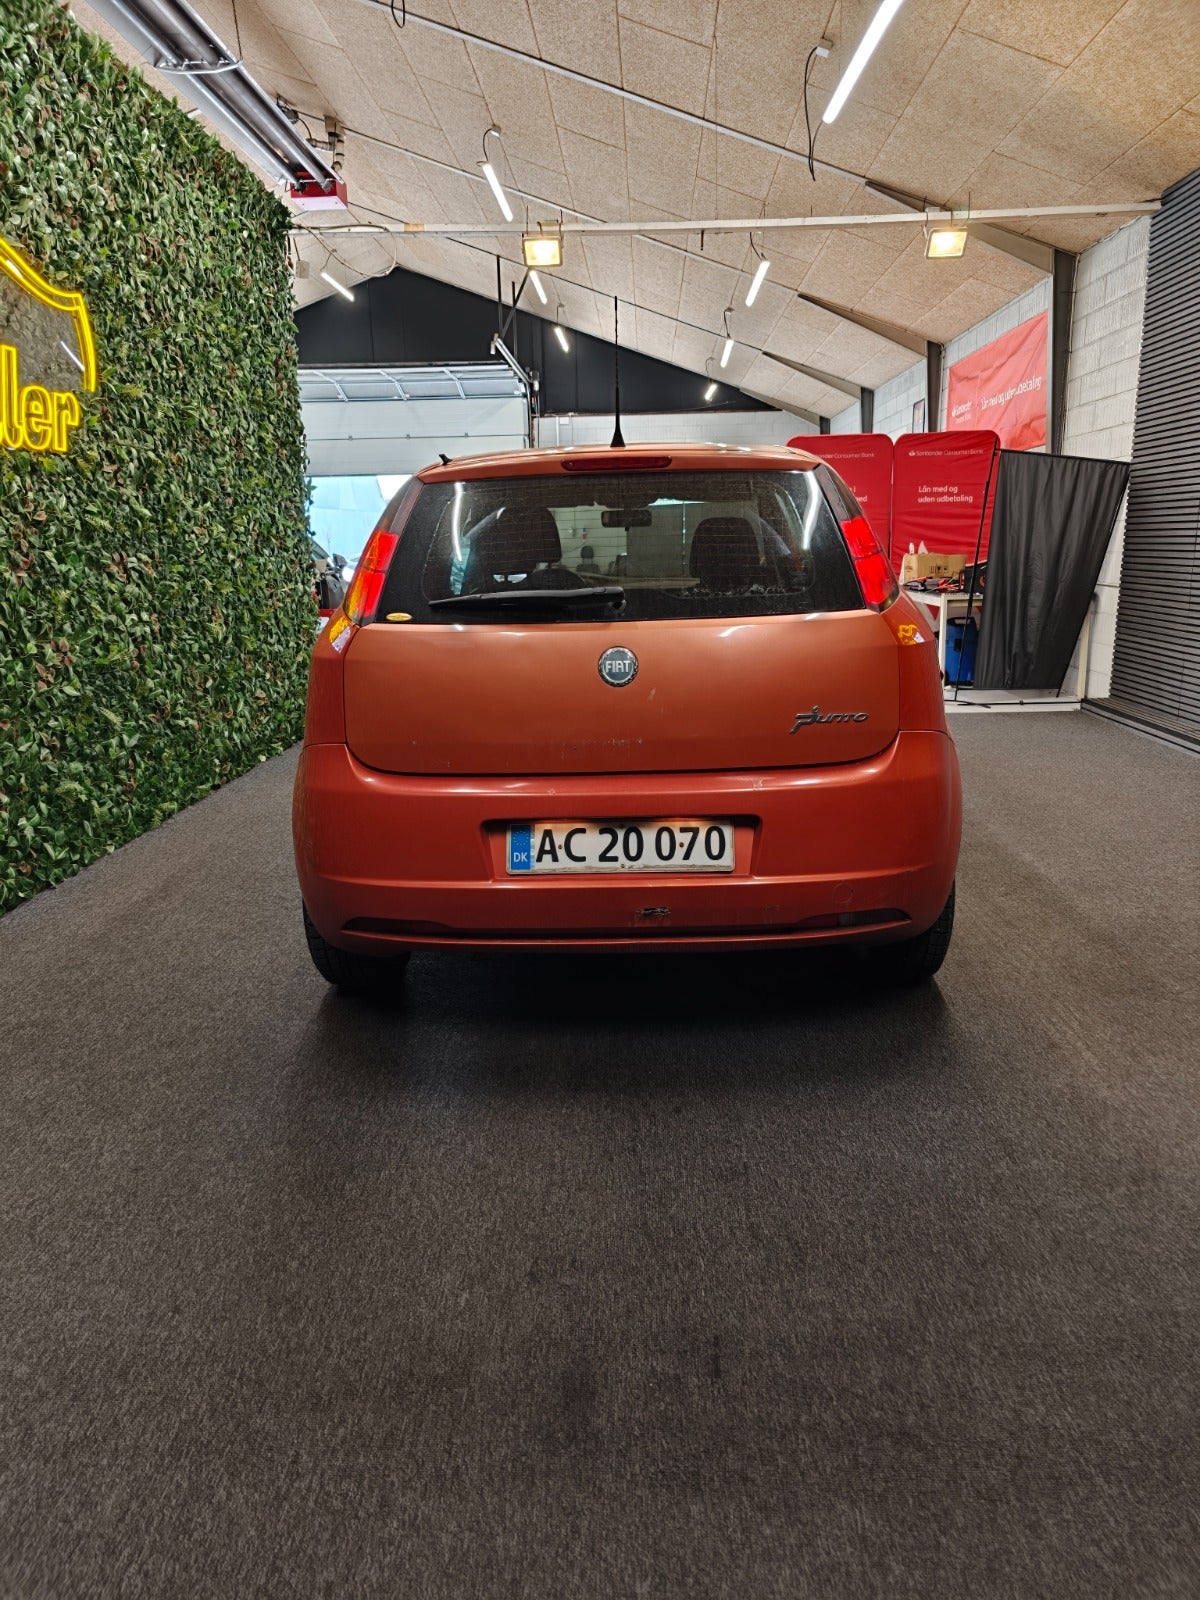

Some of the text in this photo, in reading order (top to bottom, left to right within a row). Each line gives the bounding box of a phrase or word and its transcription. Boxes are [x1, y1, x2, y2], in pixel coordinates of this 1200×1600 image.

[0, 344, 80, 452] ler
[918, 485, 958, 494] Lån med og
[937, 494, 974, 504] udbetaling
[605, 660, 631, 673] FIAT
[535, 825, 726, 863] AC 20 070
[513, 851, 528, 863] DK
